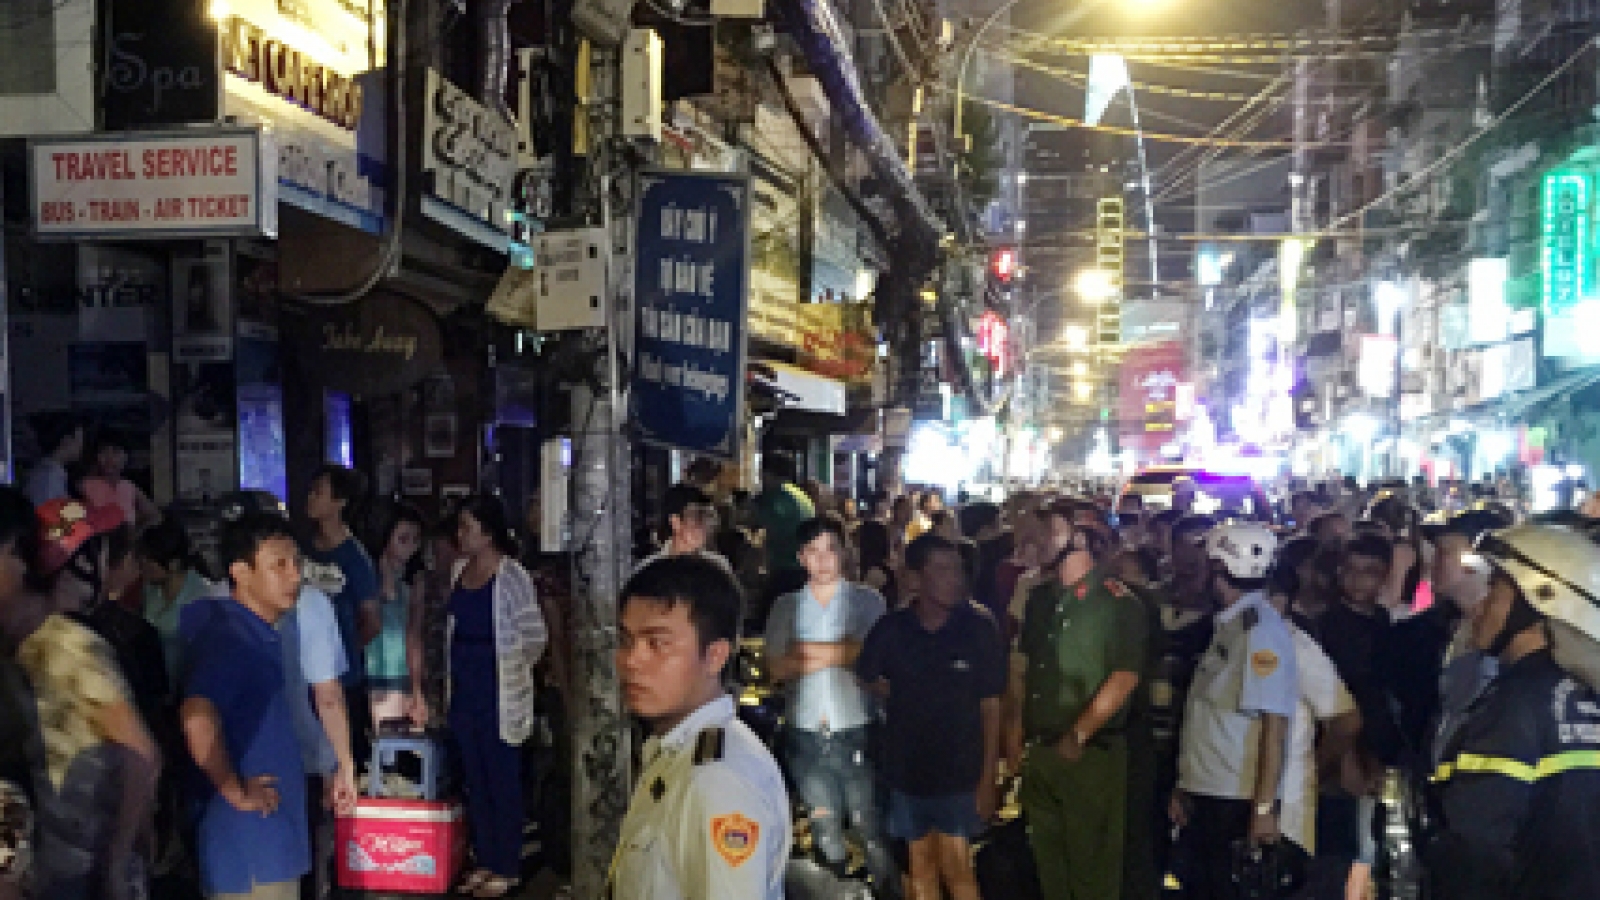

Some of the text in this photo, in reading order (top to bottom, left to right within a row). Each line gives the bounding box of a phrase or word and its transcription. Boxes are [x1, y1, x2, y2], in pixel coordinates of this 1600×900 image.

[109, 31, 204, 113] Spa
[52, 145, 238, 181] TRAVEL SERVICE
[41, 202, 75, 224] BUS
[88, 200, 140, 221] TRAIN
[154, 198, 184, 220] AIR
[187, 195, 250, 218] TICKET
